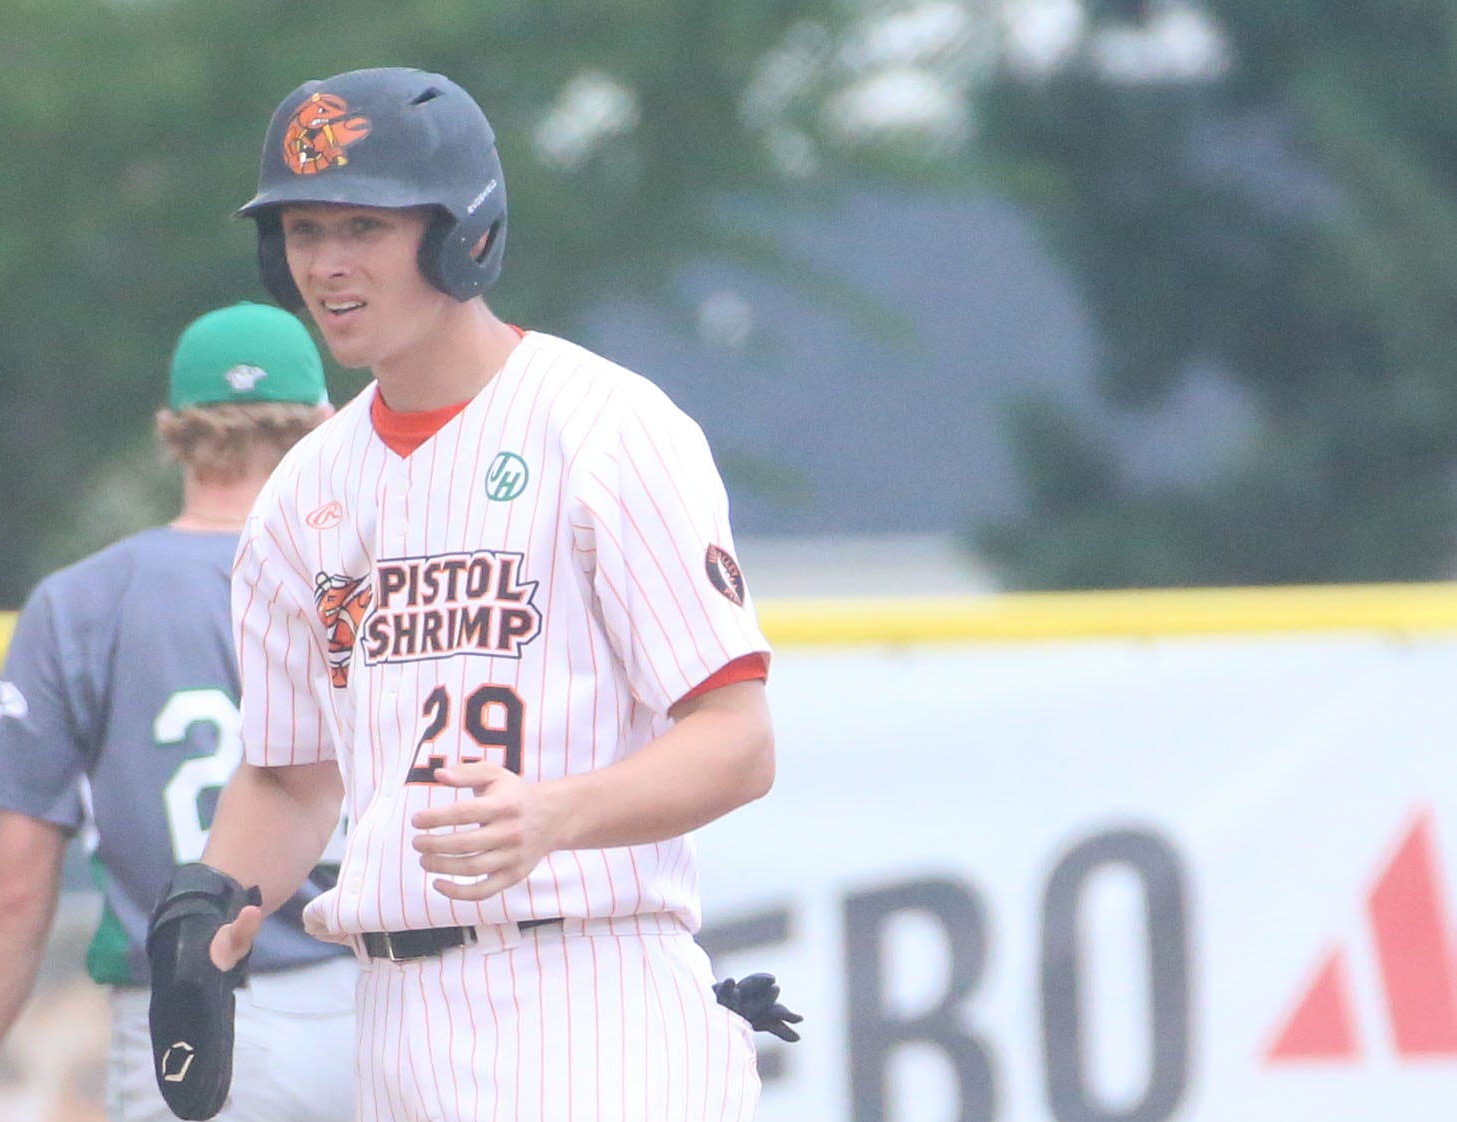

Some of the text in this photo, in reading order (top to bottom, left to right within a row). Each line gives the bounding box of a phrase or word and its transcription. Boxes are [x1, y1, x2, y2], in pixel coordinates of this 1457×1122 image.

[377, 556, 527, 608] PISTOL
[367, 604, 534, 661] SHRIMP
[405, 682, 526, 787] 29
